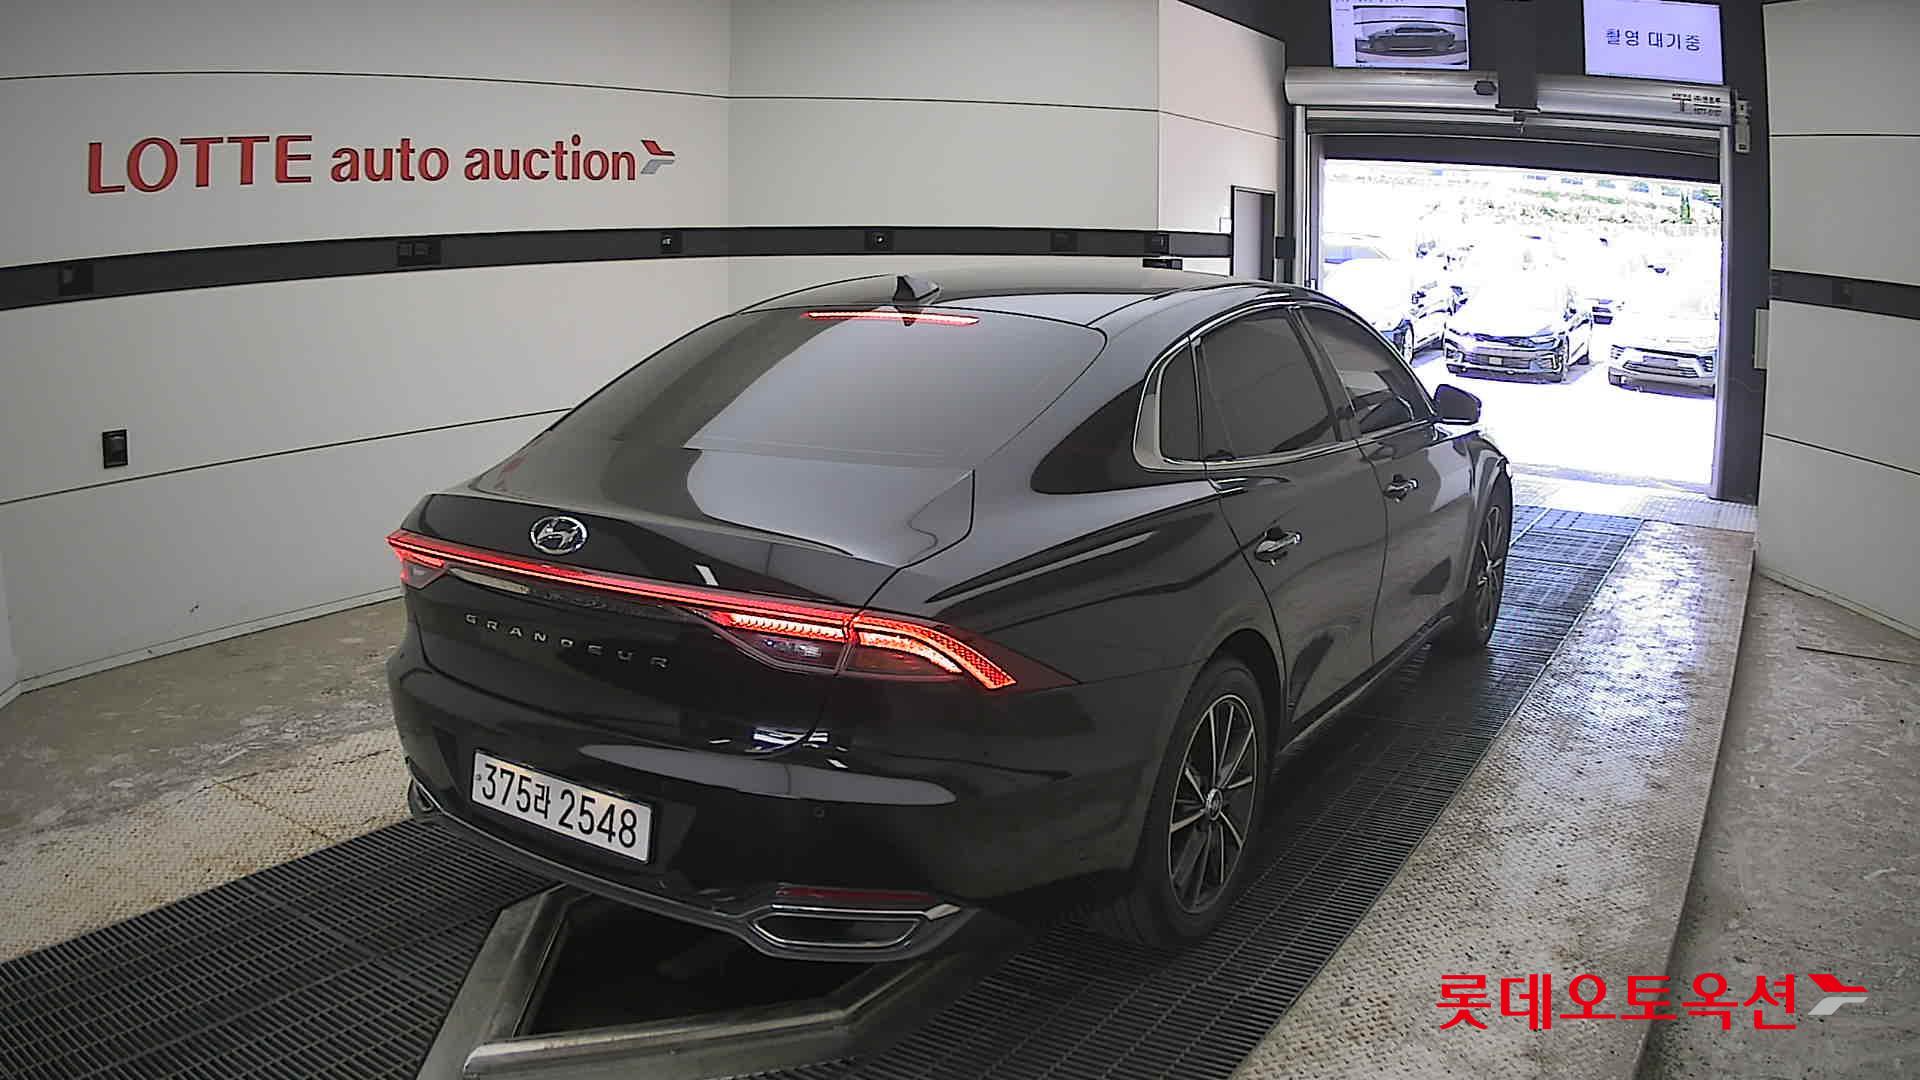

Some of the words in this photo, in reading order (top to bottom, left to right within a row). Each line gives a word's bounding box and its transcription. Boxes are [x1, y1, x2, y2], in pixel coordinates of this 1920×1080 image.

[1648, 32, 1701, 51] 대기중
[88, 135, 312, 194] LOTTE
[331, 138, 449, 182] auto
[465, 134, 636, 182] auction
[464, 613, 669, 669] GRANDEUR
[482, 763, 551, 819] 375라
[558, 788, 637, 848] 2548
